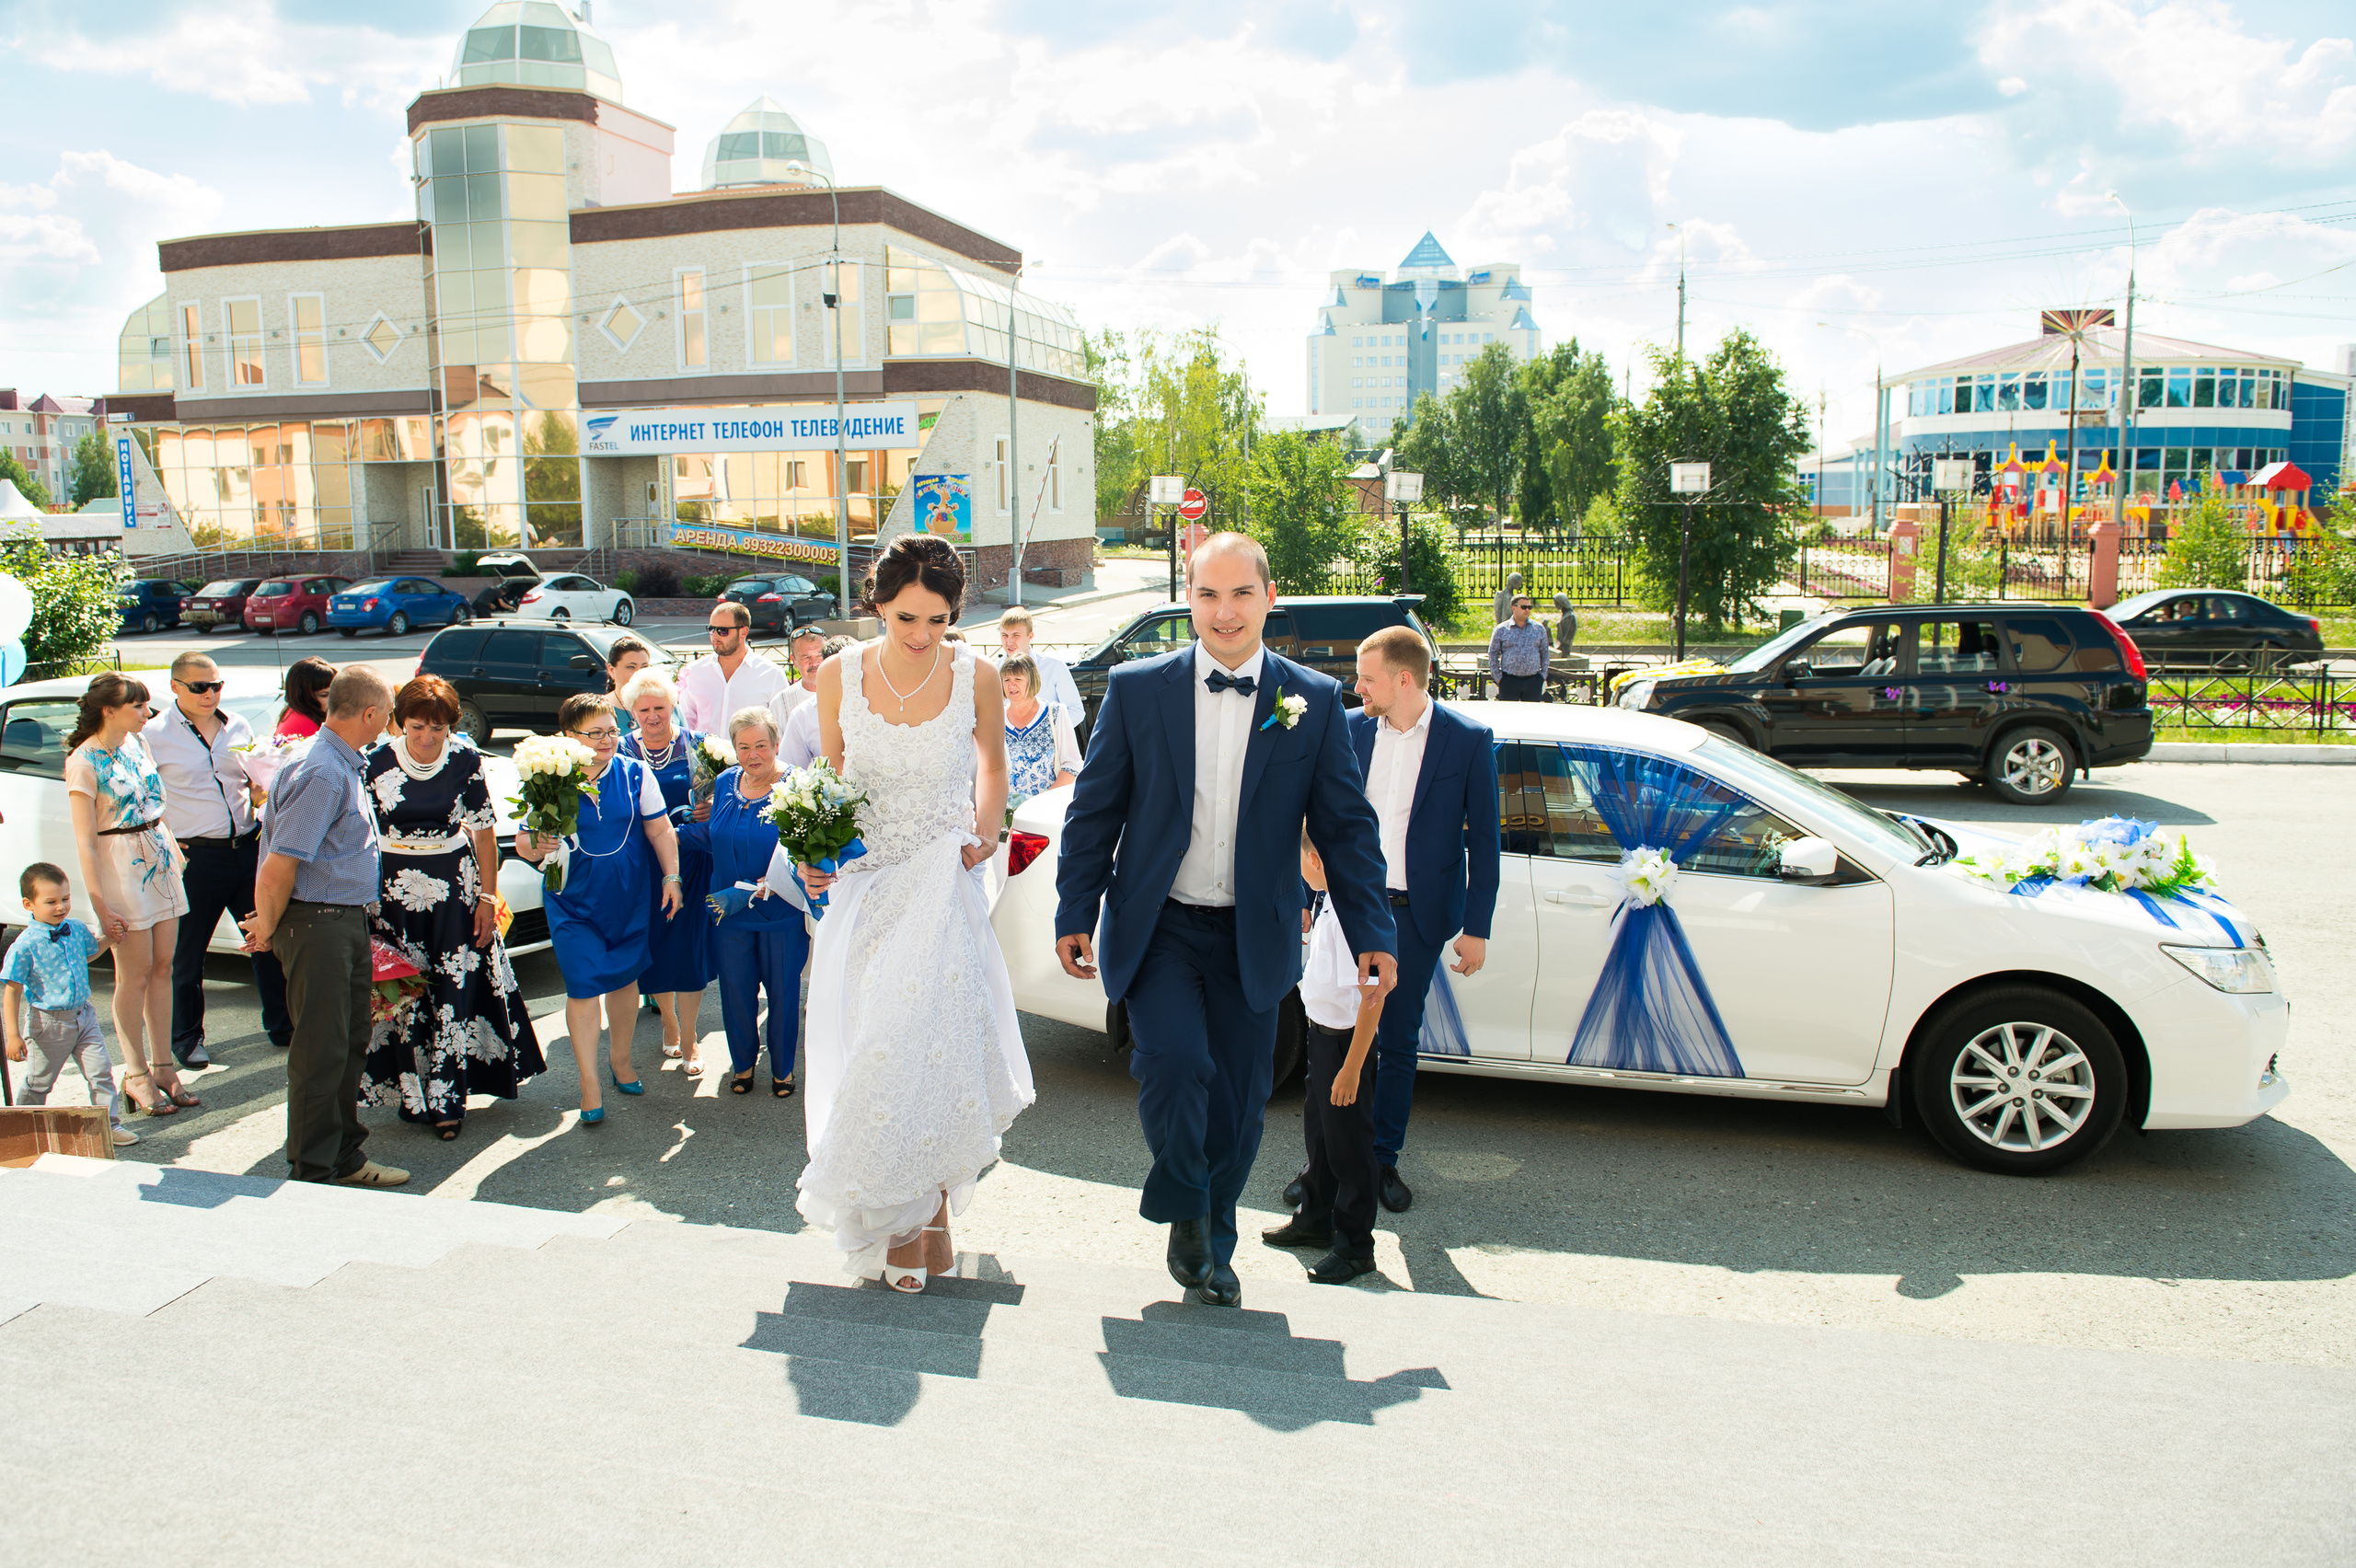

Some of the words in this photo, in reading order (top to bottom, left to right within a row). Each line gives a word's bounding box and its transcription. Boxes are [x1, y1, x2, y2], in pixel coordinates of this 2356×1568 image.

[630, 423, 706, 441] ИНТЕРНЕТ
[712, 421, 783, 439] ТЕЛЕФОН
[791, 417, 905, 439] ТЕЛЕВИДЕНИЕ
[589, 442, 619, 450] FASTEL
[120, 443, 133, 525] НОТАРИУС
[936, 513, 953, 522] ABC
[674, 529, 738, 549] АРЕНДА
[742, 536, 837, 560] 89322300003
